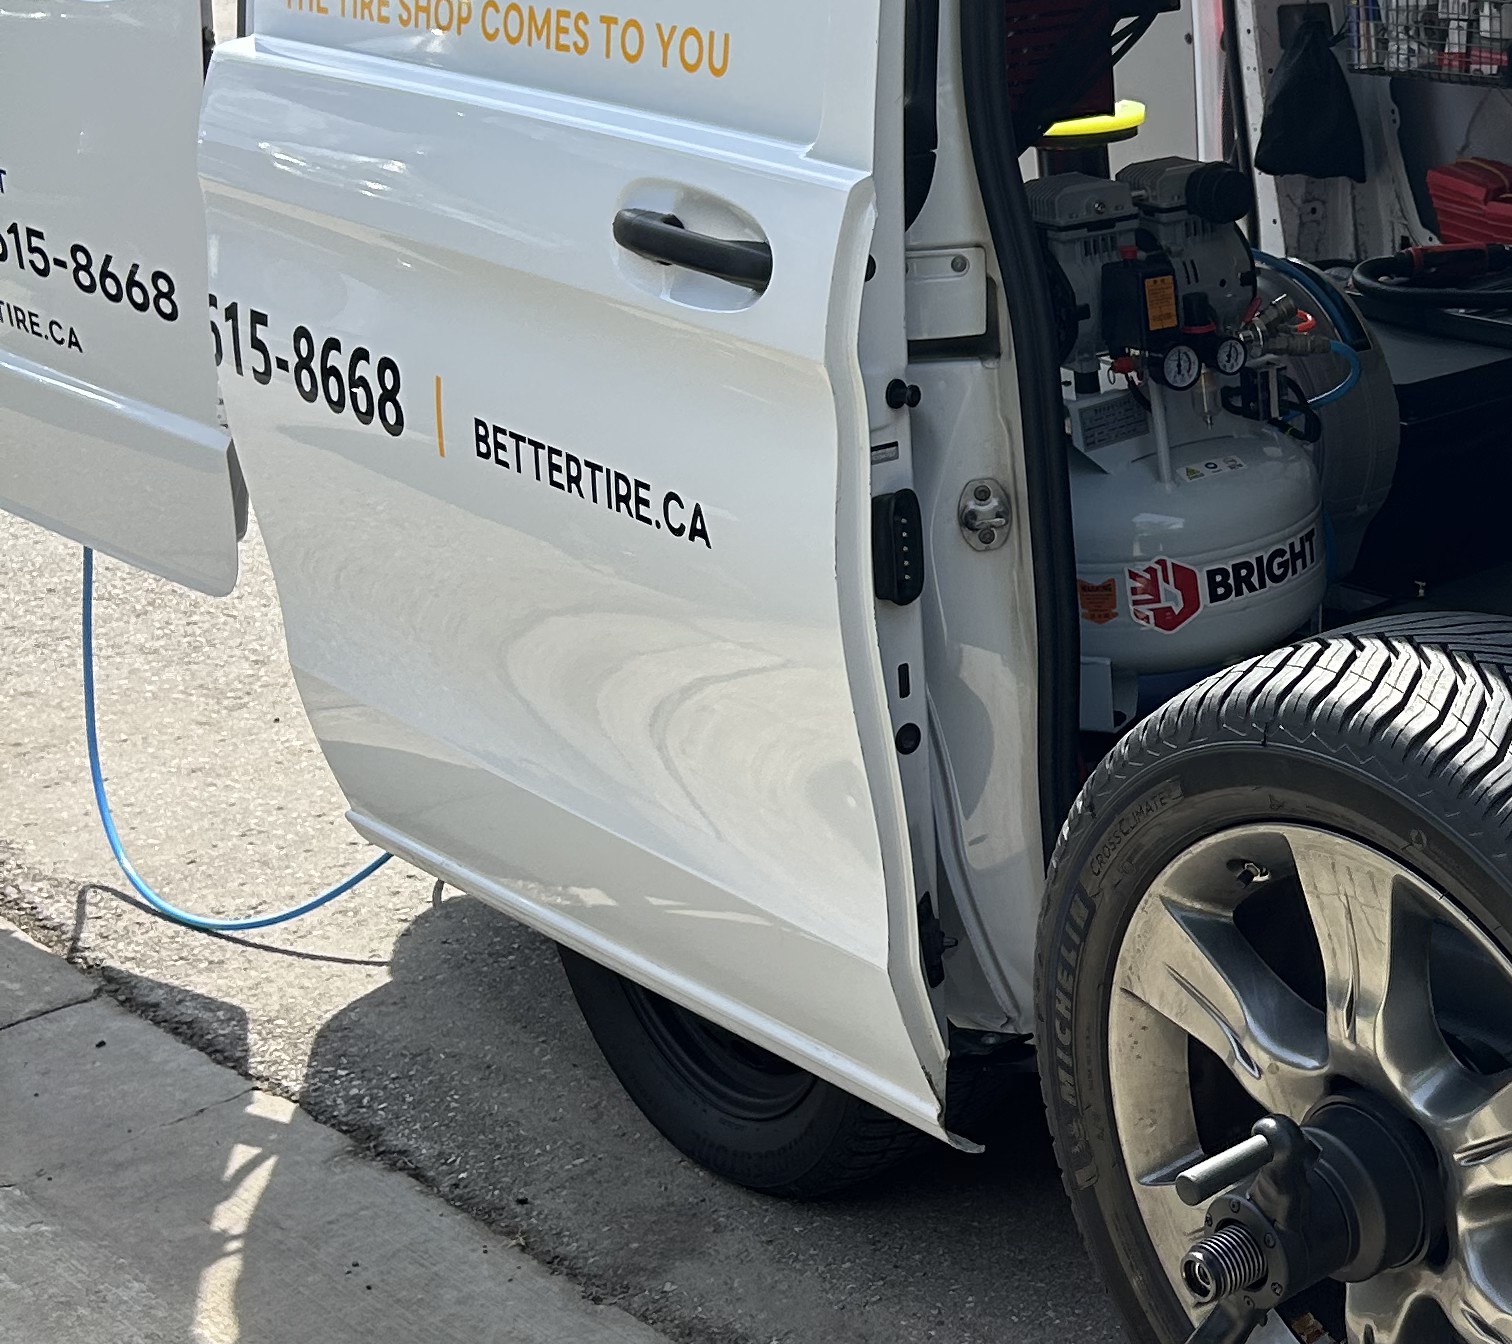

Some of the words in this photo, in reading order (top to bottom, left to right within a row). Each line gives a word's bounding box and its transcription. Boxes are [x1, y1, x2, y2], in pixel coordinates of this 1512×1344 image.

[481, 0, 590, 56] COMES
[599, 15, 645, 64] TO
[656, 22, 730, 78] YOU
[473, 417, 712, 550] BETTERTIRE.CA
[1205, 527, 1316, 604] BRIGHT
[1055, 891, 1097, 1108] MICHELIN
